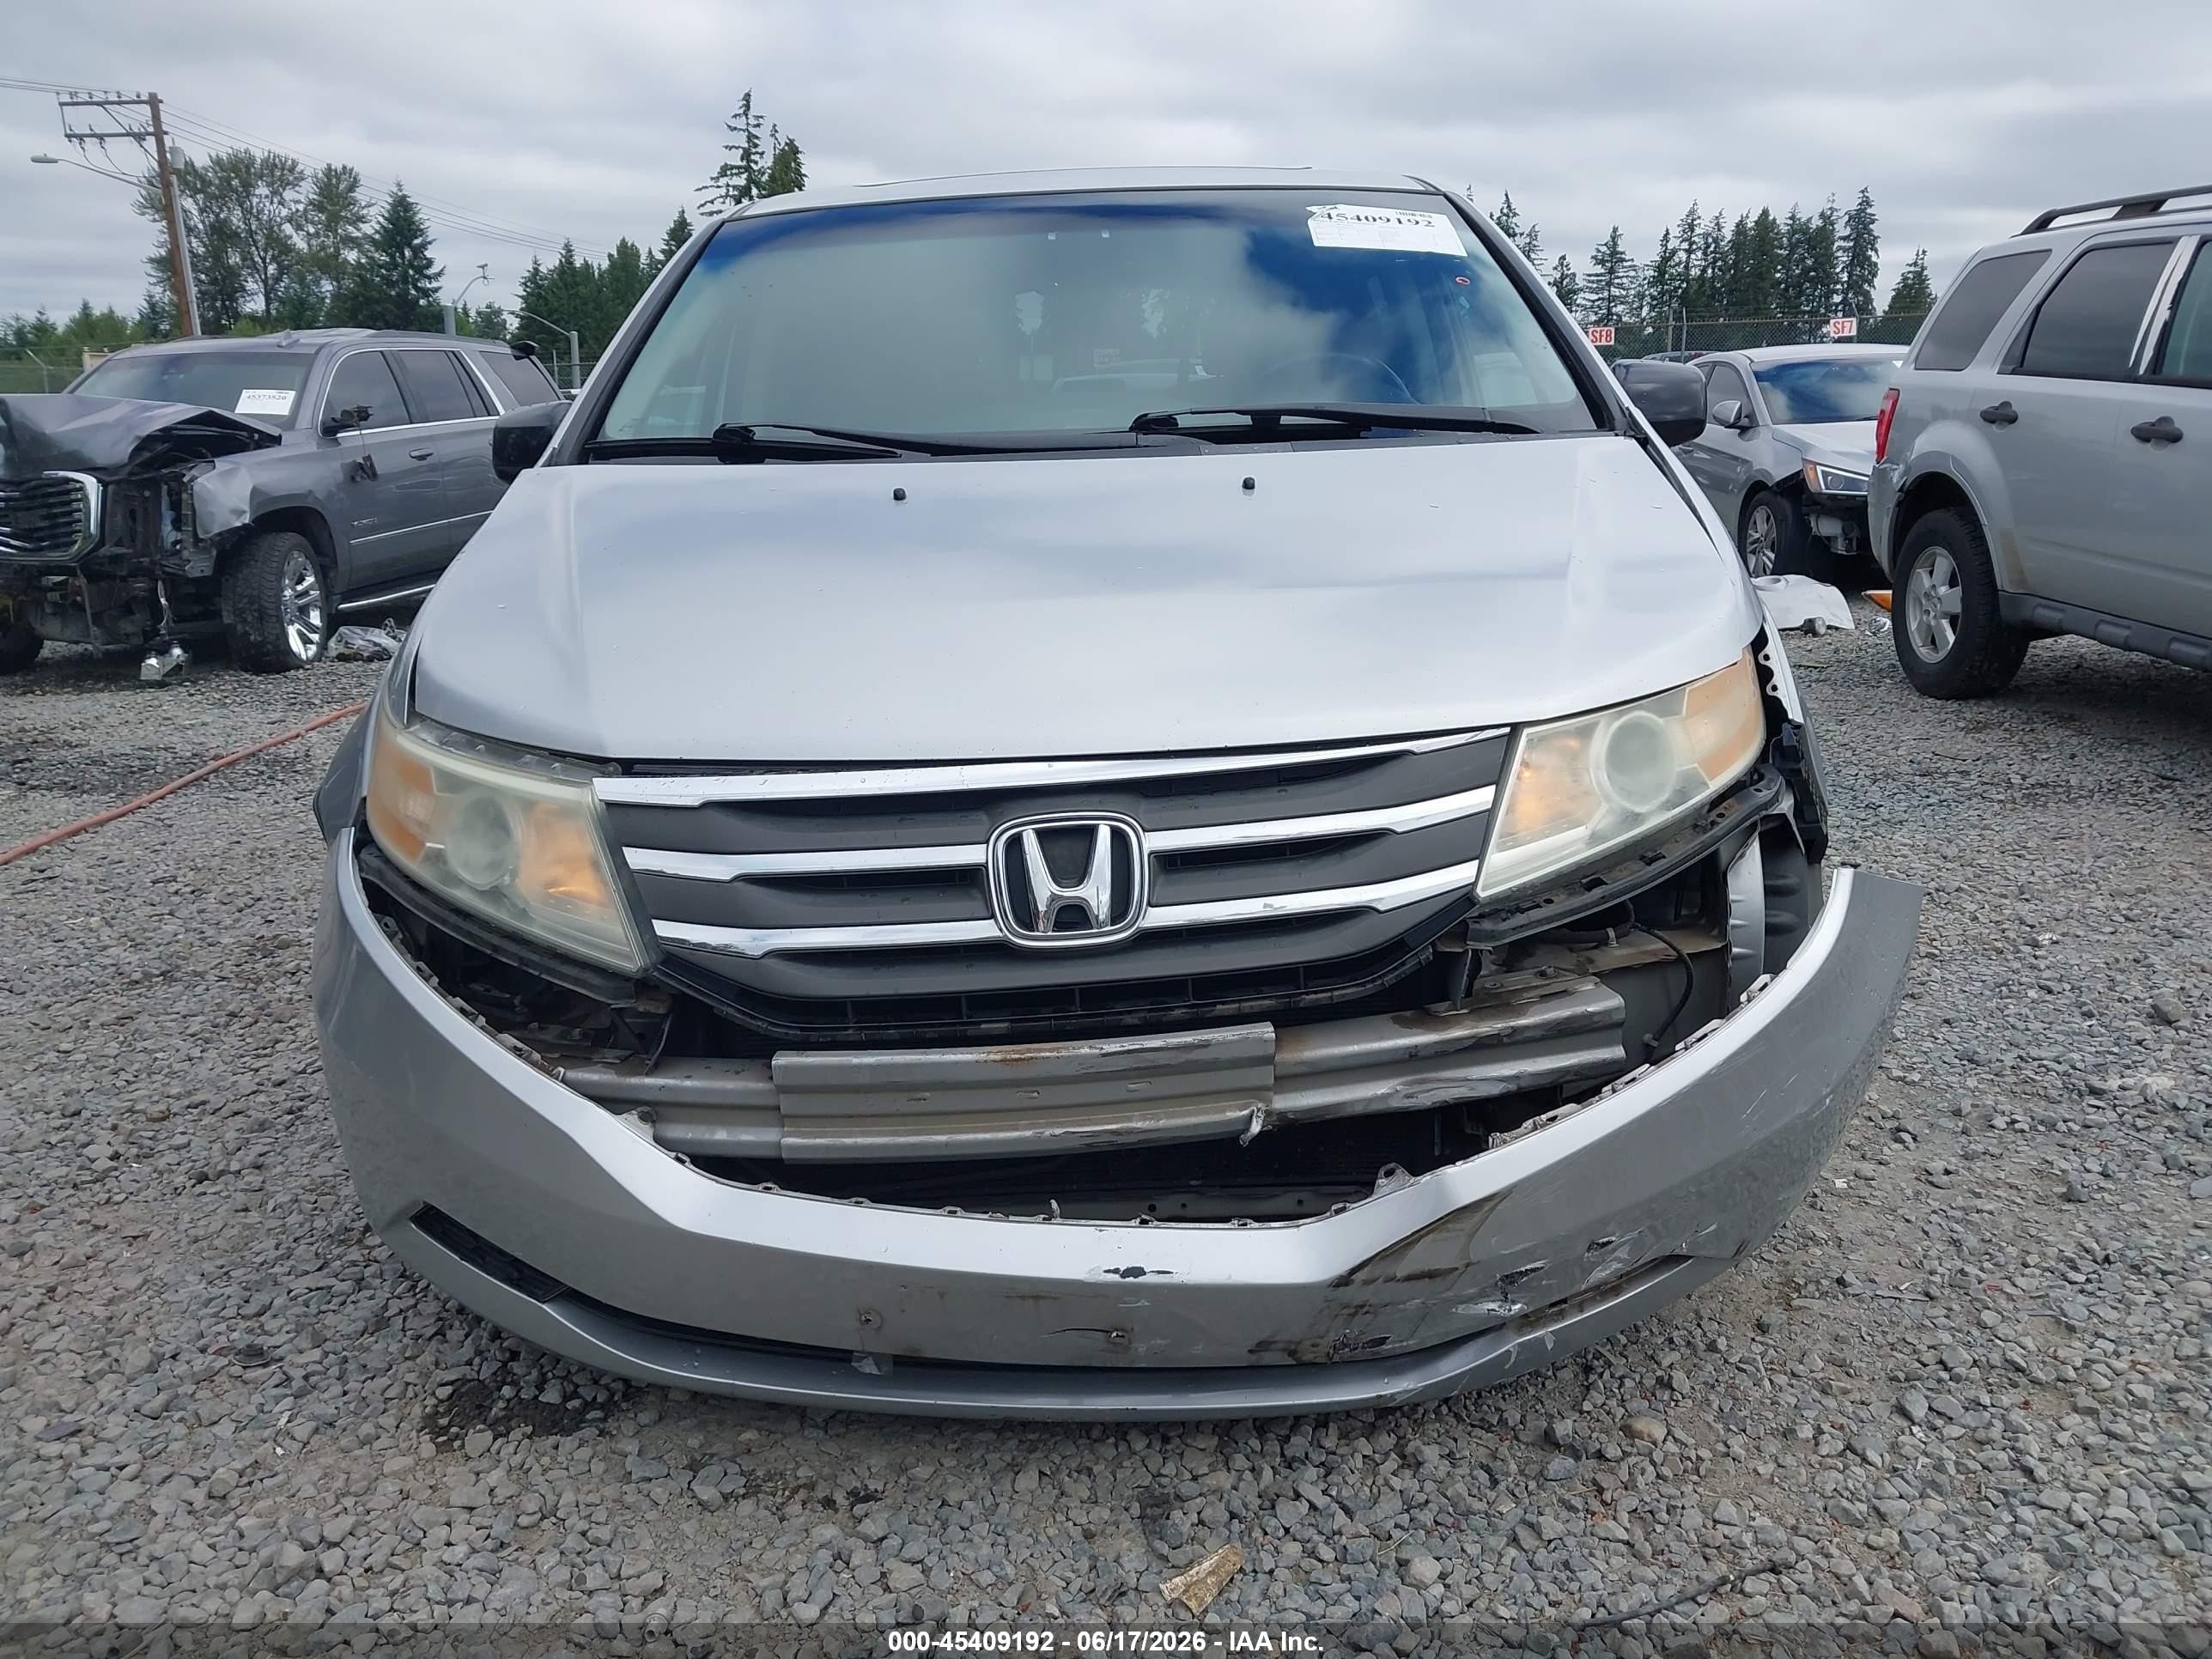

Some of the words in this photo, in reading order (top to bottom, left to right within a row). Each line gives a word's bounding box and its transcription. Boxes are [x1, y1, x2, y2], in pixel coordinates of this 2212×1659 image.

[1320, 212, 1436, 228] 45409192
[1832, 319, 1854, 335] SF7
[1590, 328, 1613, 343] SF8
